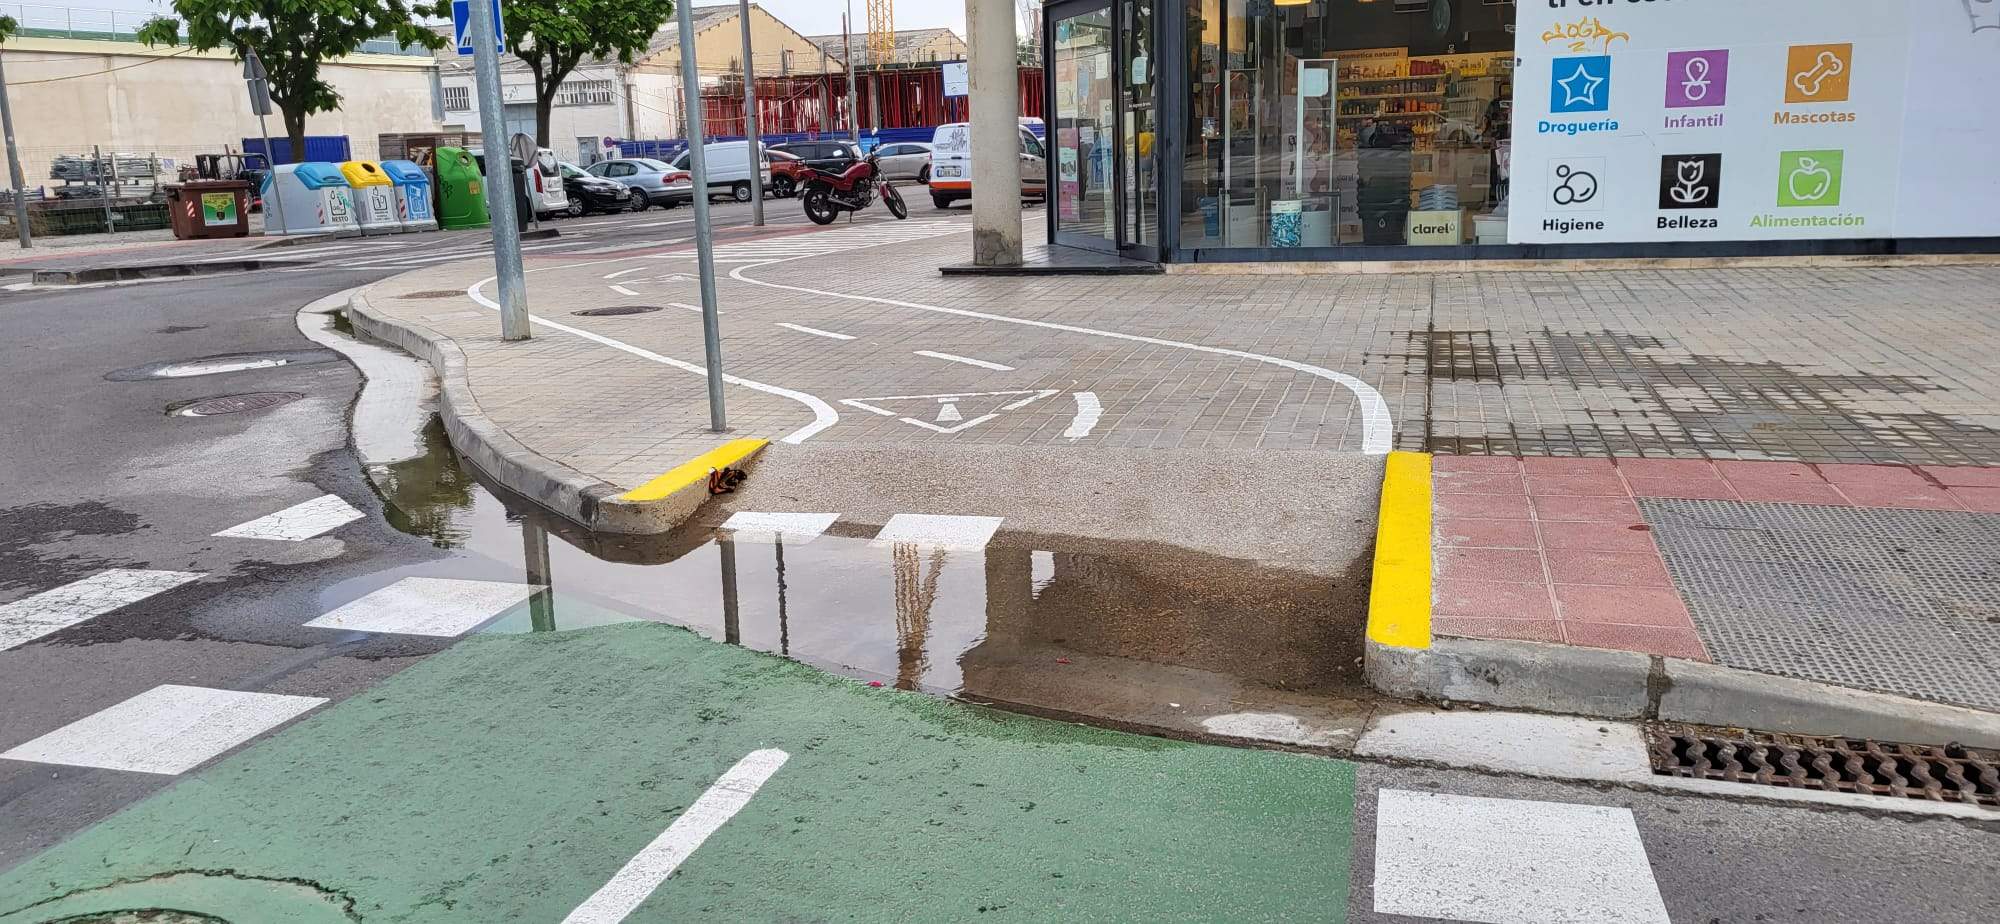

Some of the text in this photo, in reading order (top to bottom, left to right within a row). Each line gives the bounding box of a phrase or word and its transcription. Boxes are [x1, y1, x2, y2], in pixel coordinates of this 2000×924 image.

[1374, 50, 1400, 58] natural
[1664, 113, 1724, 129] Infantil
[1774, 111, 1856, 125] Mascotas
[1538, 118, 1619, 136] Droguería
[1543, 218, 1605, 234] Higiene
[1656, 216, 1718, 229] Belleza
[1750, 213, 1865, 228] Alimentación
[1412, 223, 1450, 234] clarel
